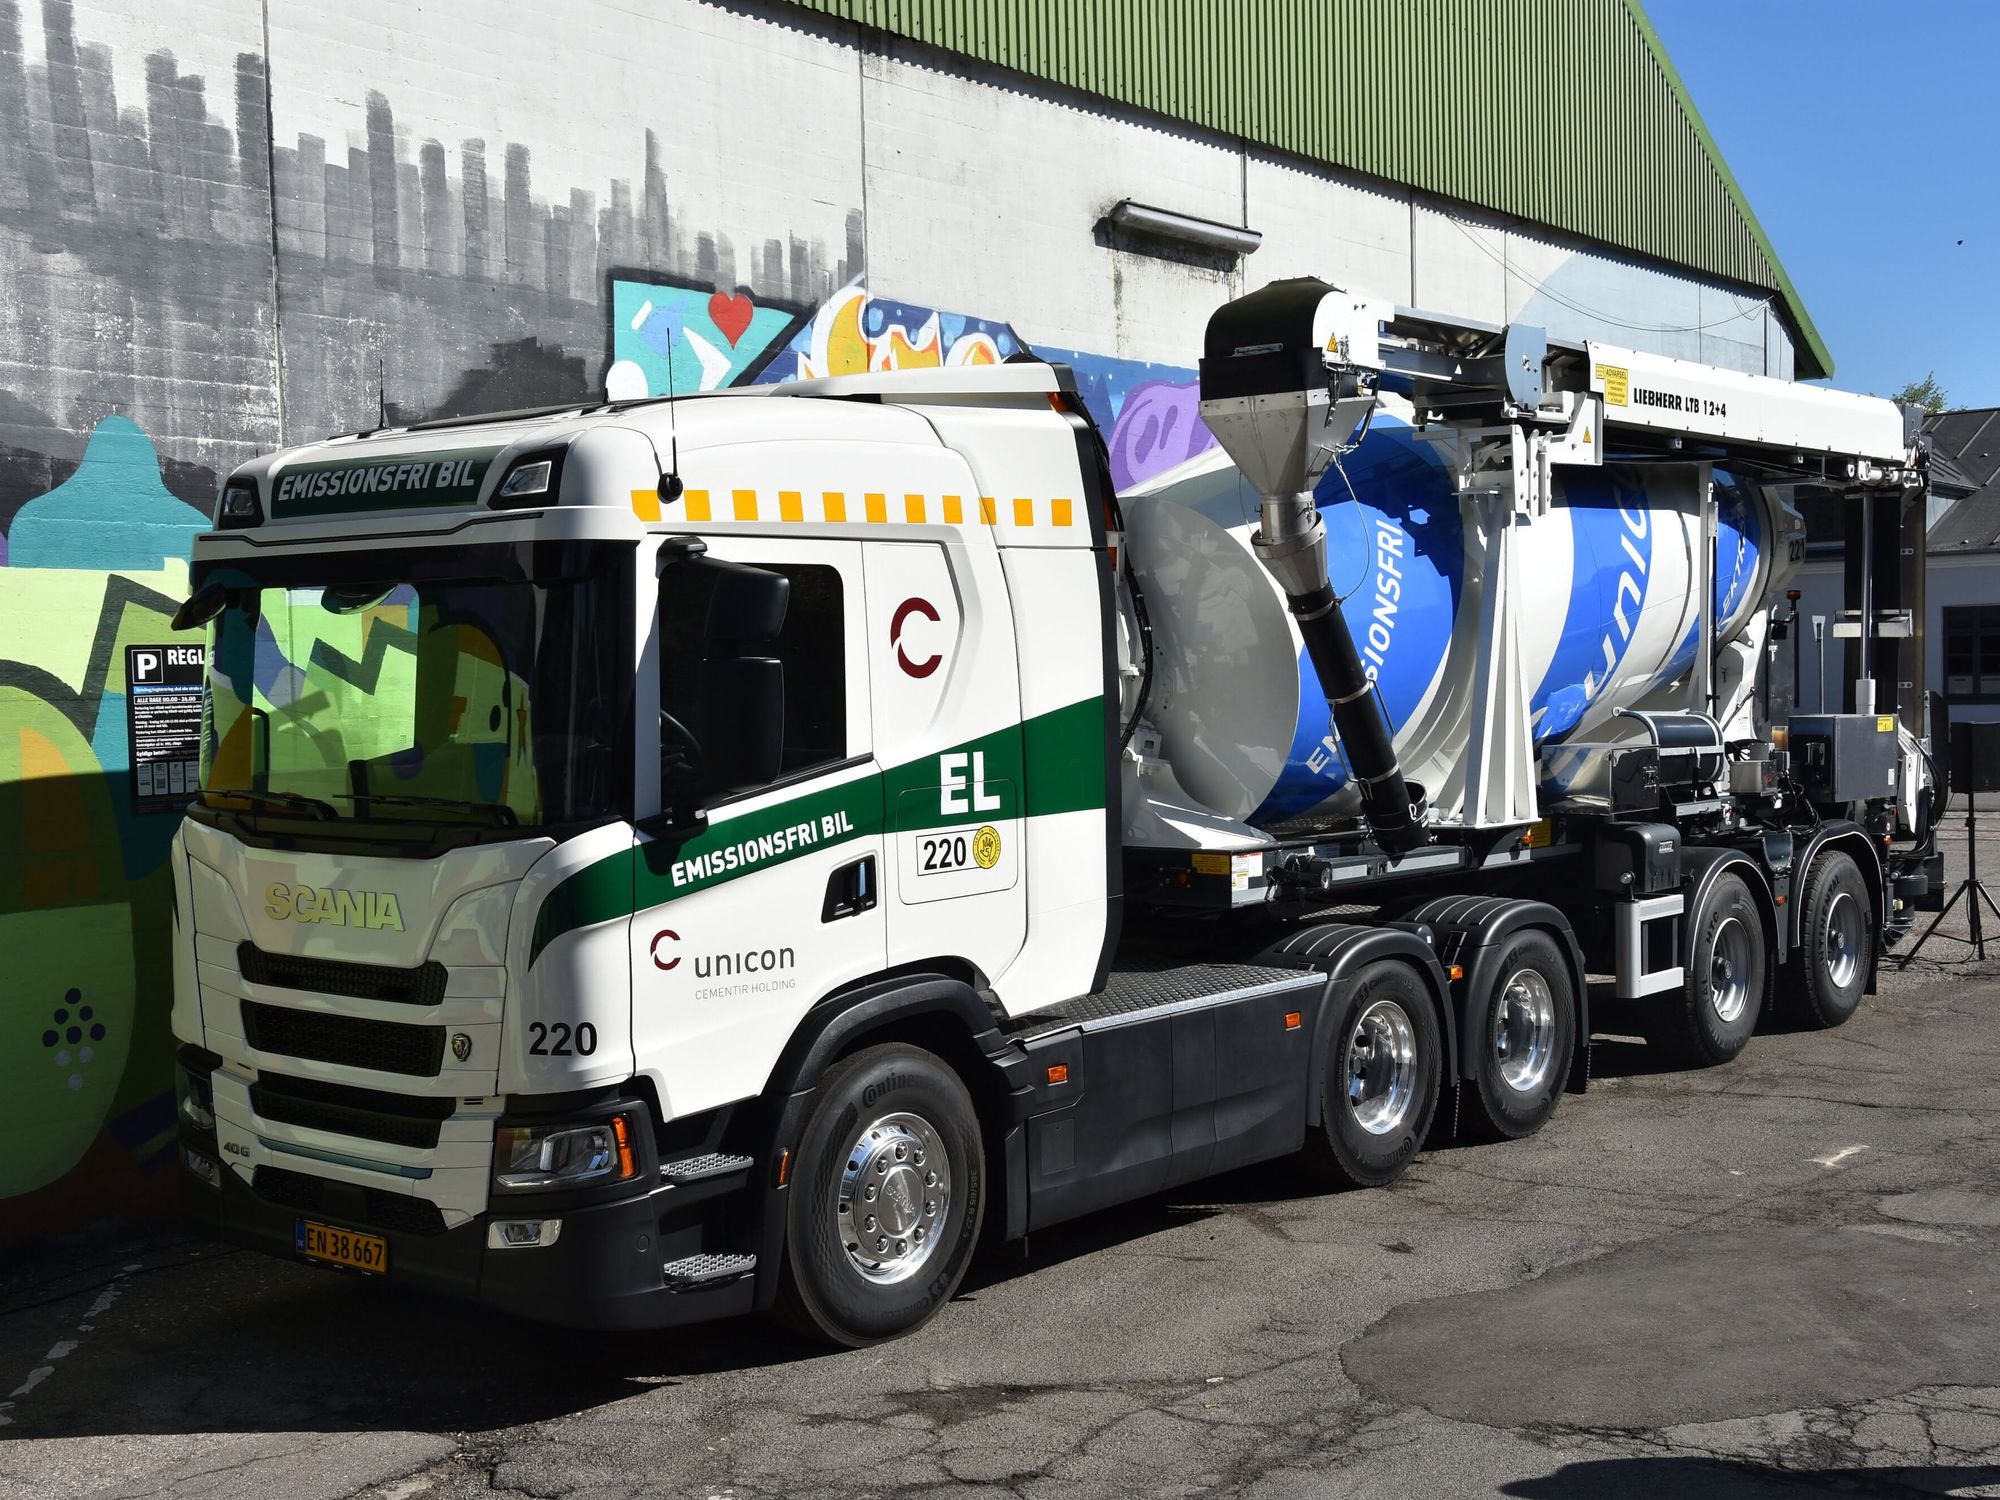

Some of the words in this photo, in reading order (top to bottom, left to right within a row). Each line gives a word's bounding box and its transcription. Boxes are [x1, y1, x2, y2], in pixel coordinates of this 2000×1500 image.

[1633, 387, 1682, 411] LIEBHERR
[1685, 396, 1700, 414] LTB
[278, 463, 431, 501] EMISSIONSFRI
[435, 460, 475, 488] BIL
[167, 648, 205, 666] REGL
[1305, 519, 1404, 775] ESIONSFRI
[137, 653, 158, 680] P
[939, 751, 1001, 815] EL
[671, 825, 819, 888] EMISSIONSFRI
[822, 810, 854, 837] BIL
[923, 836, 967, 870] 220
[264, 882, 405, 931] SCANIA
[694, 947, 796, 979] unicon
[695, 985, 749, 1001] CEMENTIR
[751, 978, 796, 994] HOLDING
[528, 1021, 598, 1057] 220
[306, 1227, 327, 1254] EN
[330, 1232, 350, 1260] 38
[353, 1238, 384, 1267] 667
